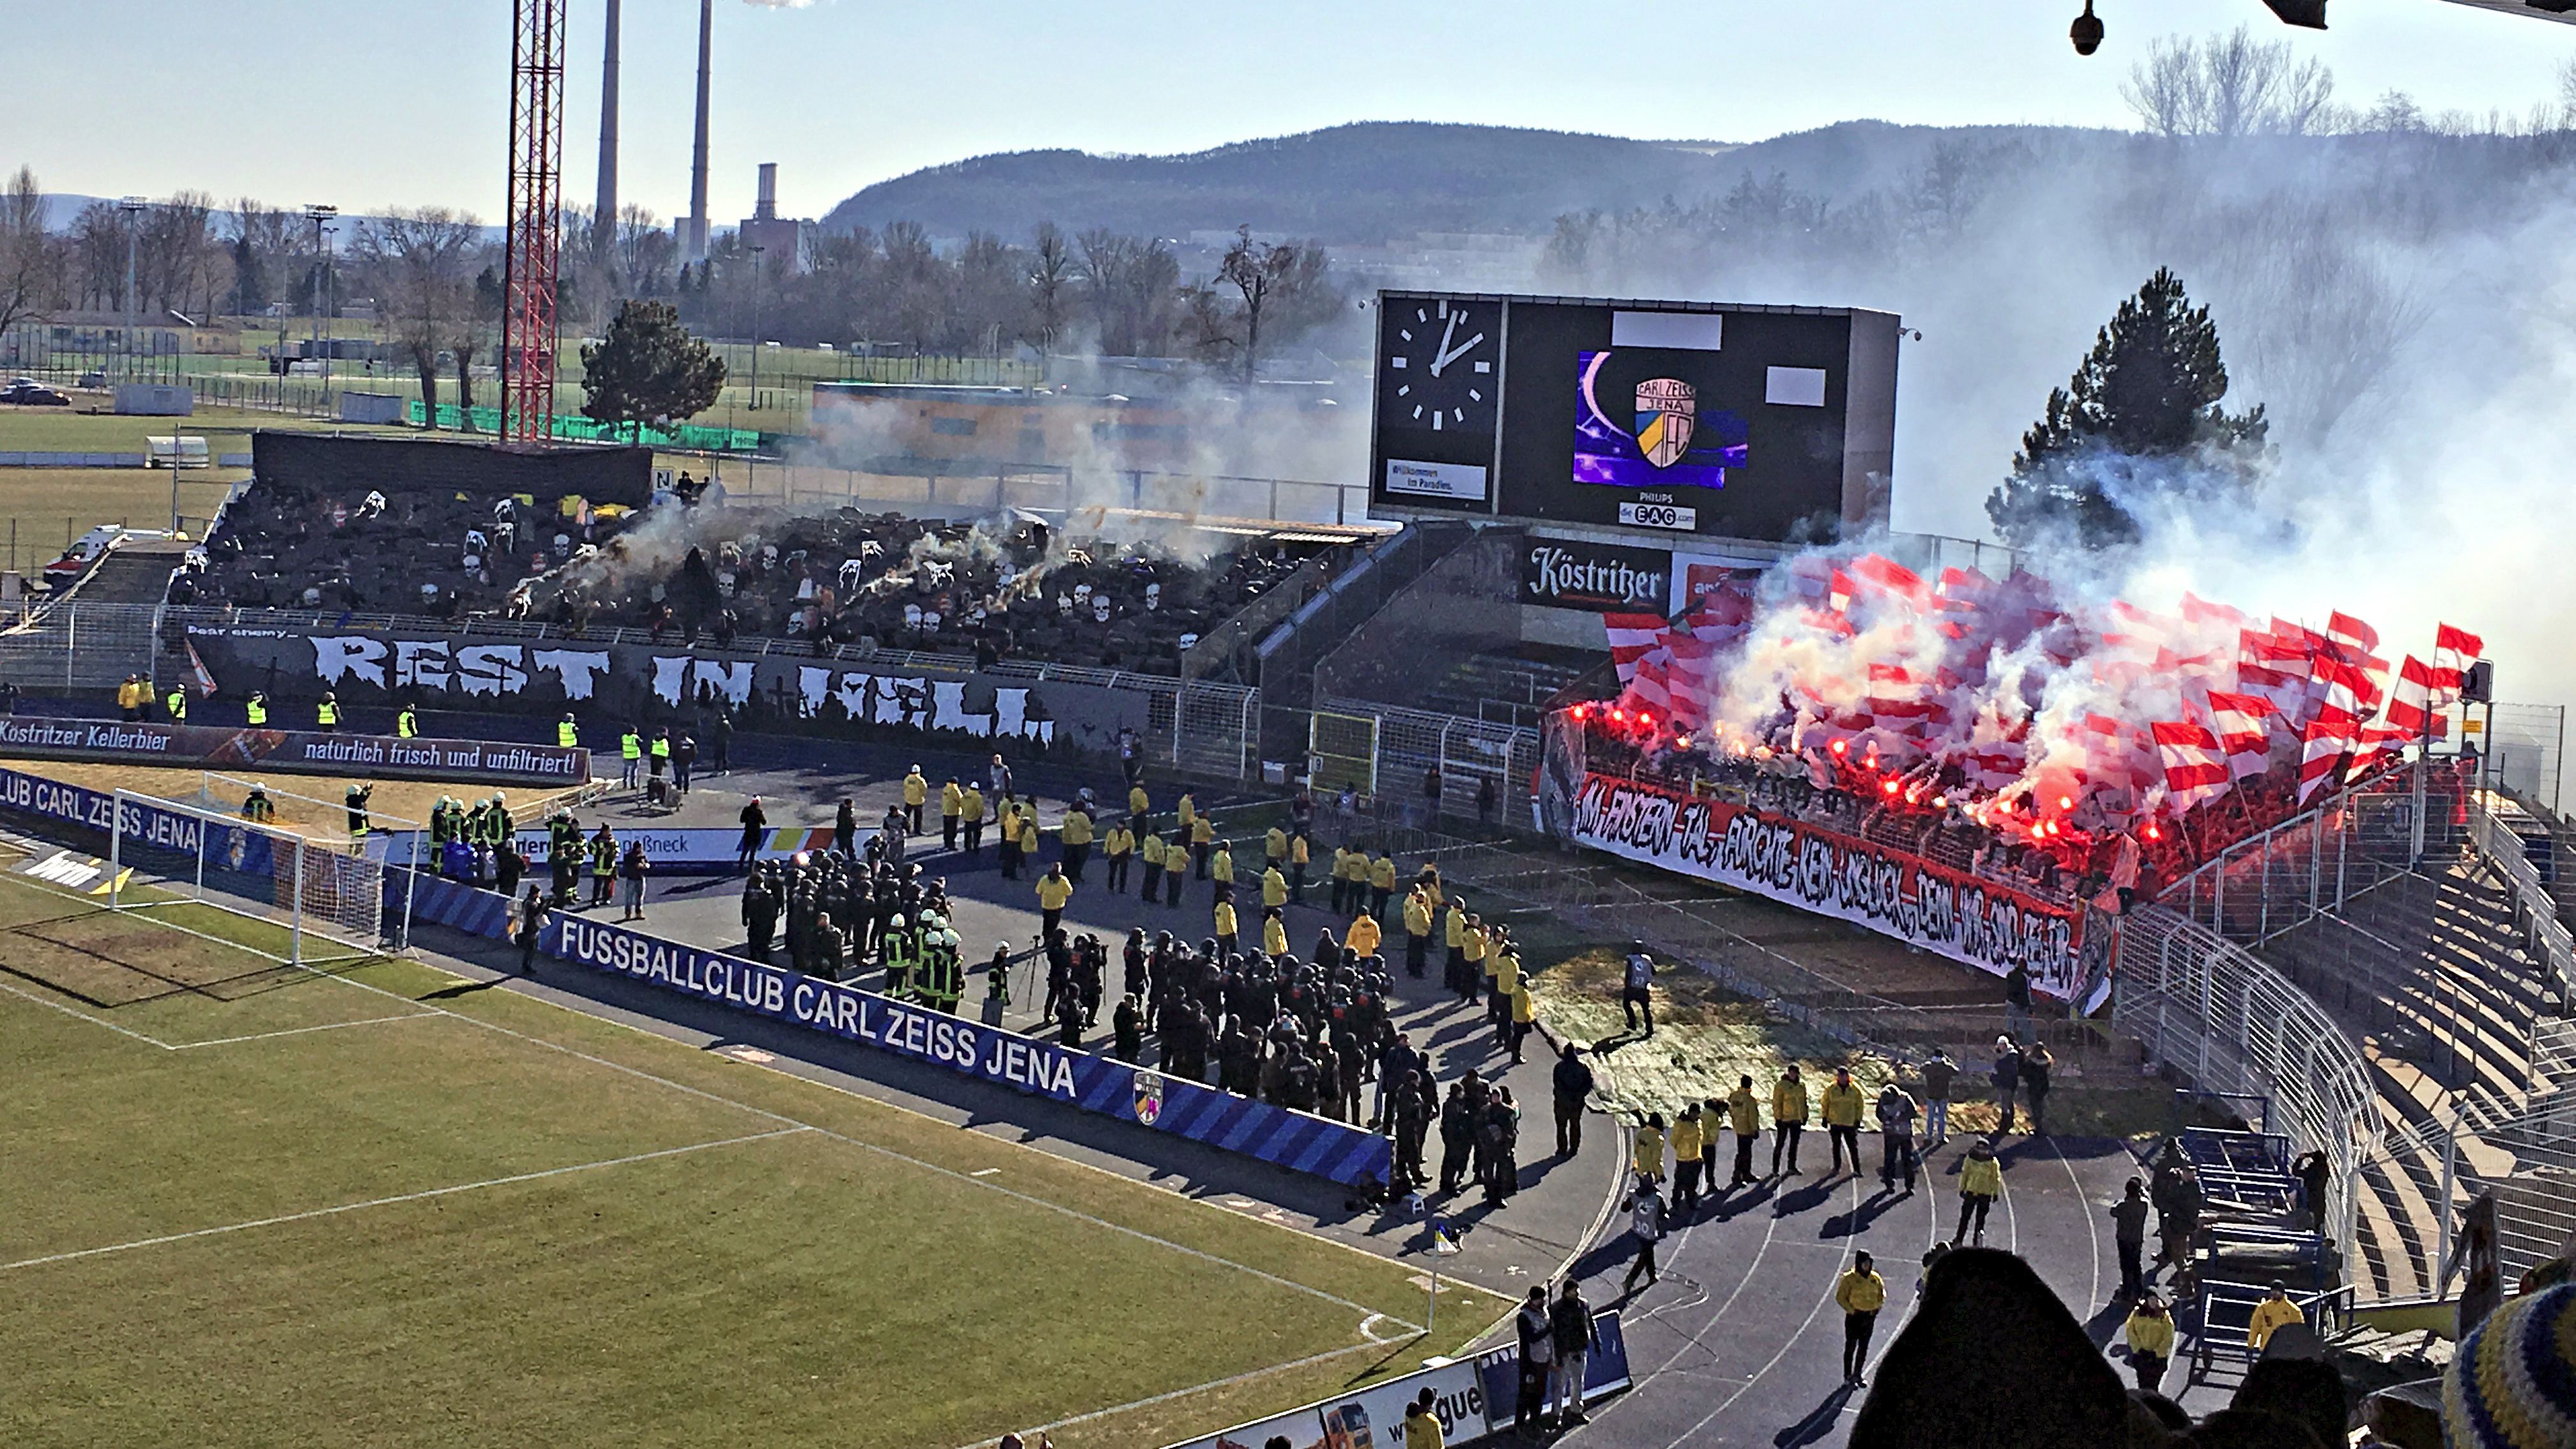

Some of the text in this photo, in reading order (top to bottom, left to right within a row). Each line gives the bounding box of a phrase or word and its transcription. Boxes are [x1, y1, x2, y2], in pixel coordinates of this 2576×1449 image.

[1639, 381, 1696, 397] CARL ZEISS
[1646, 399, 1683, 411] JENA
[657, 472, 670, 488] N
[1393, 465, 1438, 477] Willkommen
[1640, 492, 1673, 503] PHILIPS
[1529, 547, 1660, 603] Köstritzer
[188, 625, 226, 635] Dear
[308, 636, 1055, 751] REST IN HELL
[0, 721, 171, 751] Köstritzer Kellerbier
[305, 739, 577, 774] natürlich frisch und unfiltriert!
[36, 783, 84, 821] CARL
[88, 797, 141, 836] ZESS
[146, 813, 197, 852] JENA
[562, 922, 1077, 1097] FUSSBALLCLUB CARL ZEISS JENA
